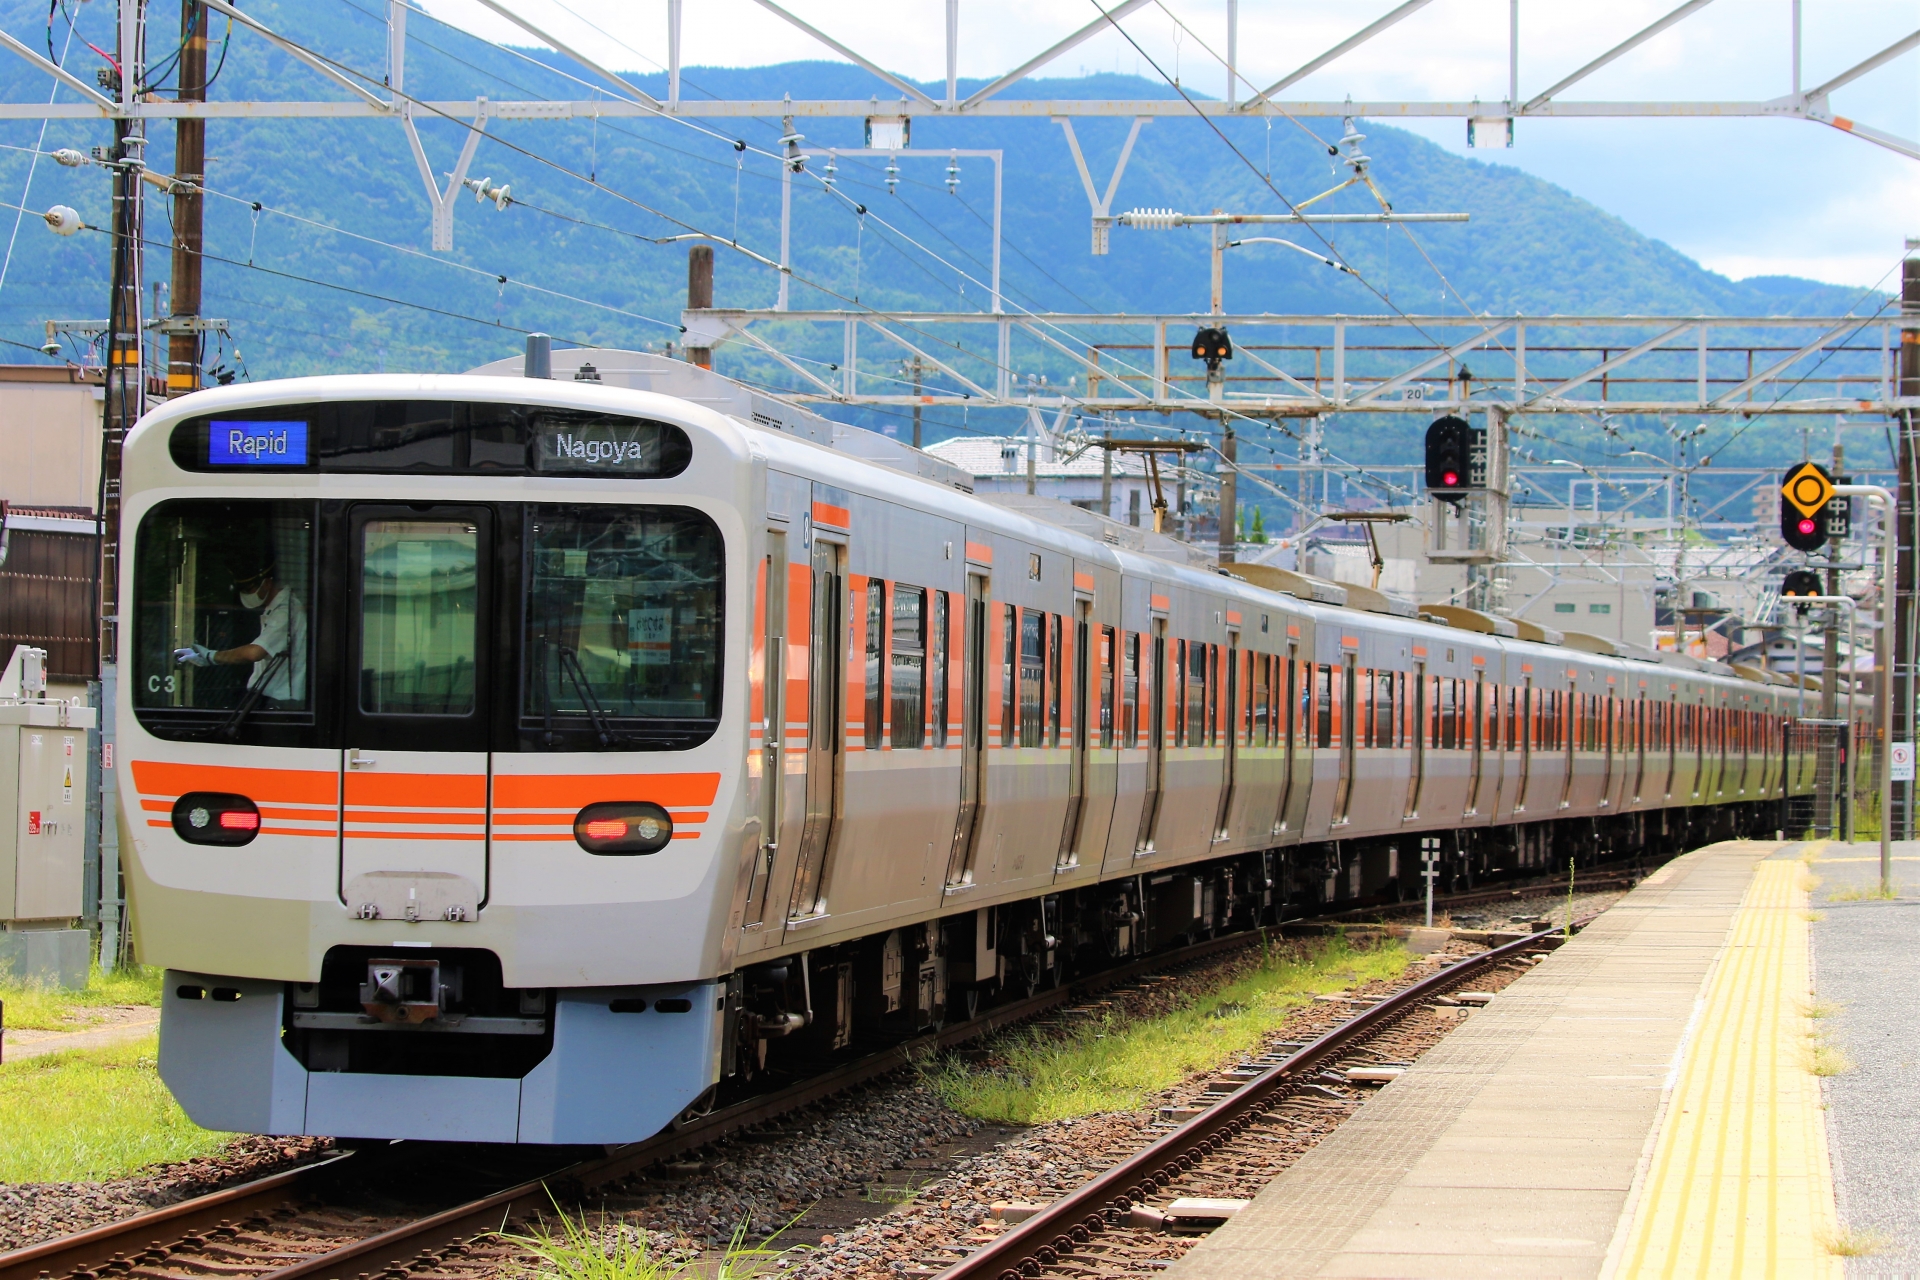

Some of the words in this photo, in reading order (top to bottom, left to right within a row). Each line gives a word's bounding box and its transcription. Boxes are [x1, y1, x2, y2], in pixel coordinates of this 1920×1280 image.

[1407, 389, 1421, 399] 20
[229, 429, 287, 459] Rapid
[556, 433, 642, 463] Nagoya
[1469, 431, 1487, 485] 上本出
[1828, 479, 1847, 534] 中出
[804, 516, 809, 544] 8
